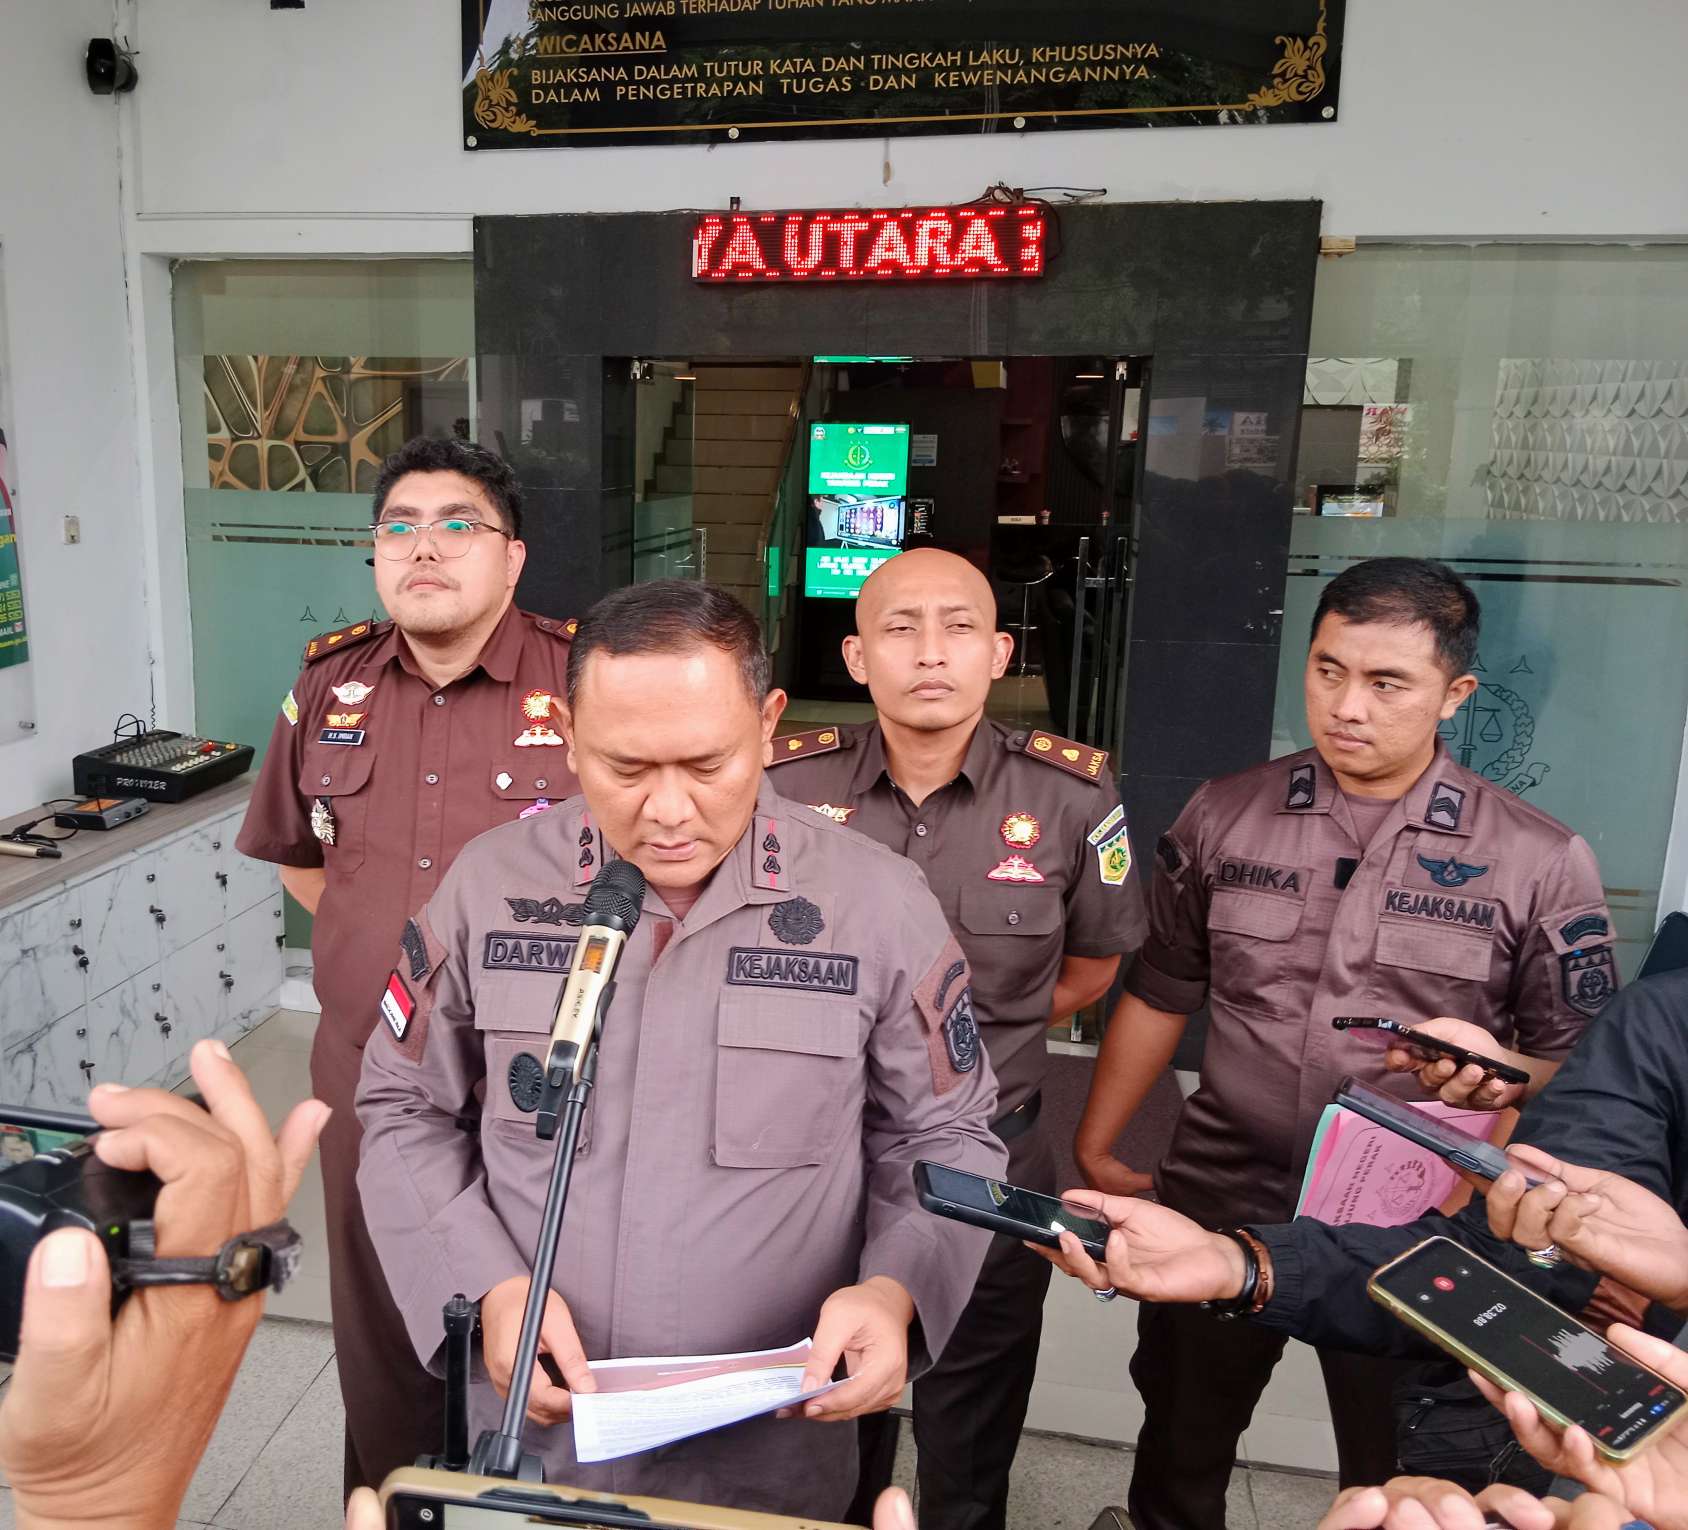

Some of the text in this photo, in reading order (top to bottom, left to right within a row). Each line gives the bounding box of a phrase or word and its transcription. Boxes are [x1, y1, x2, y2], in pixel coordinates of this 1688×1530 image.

[624, 1, 675, 18] JAWAB
[535, 30, 667, 55] WICAKSANA
[531, 43, 1159, 86] BIJAKSANA DALAM TUTUR KATA DAN TINGKAH LAKU, KHUSUSNYA
[531, 63, 1157, 105] DALAM PENGETRAPAN TUGAS DAN KEWENANGANNYA.
[784, 218, 1003, 271] UTARA
[1087, 752, 1105, 775] JAKSA
[1221, 861, 1299, 893] DHIKA
[1385, 890, 1496, 928] KEJAKSAAN
[735, 954, 851, 988] KEJAKSAAN
